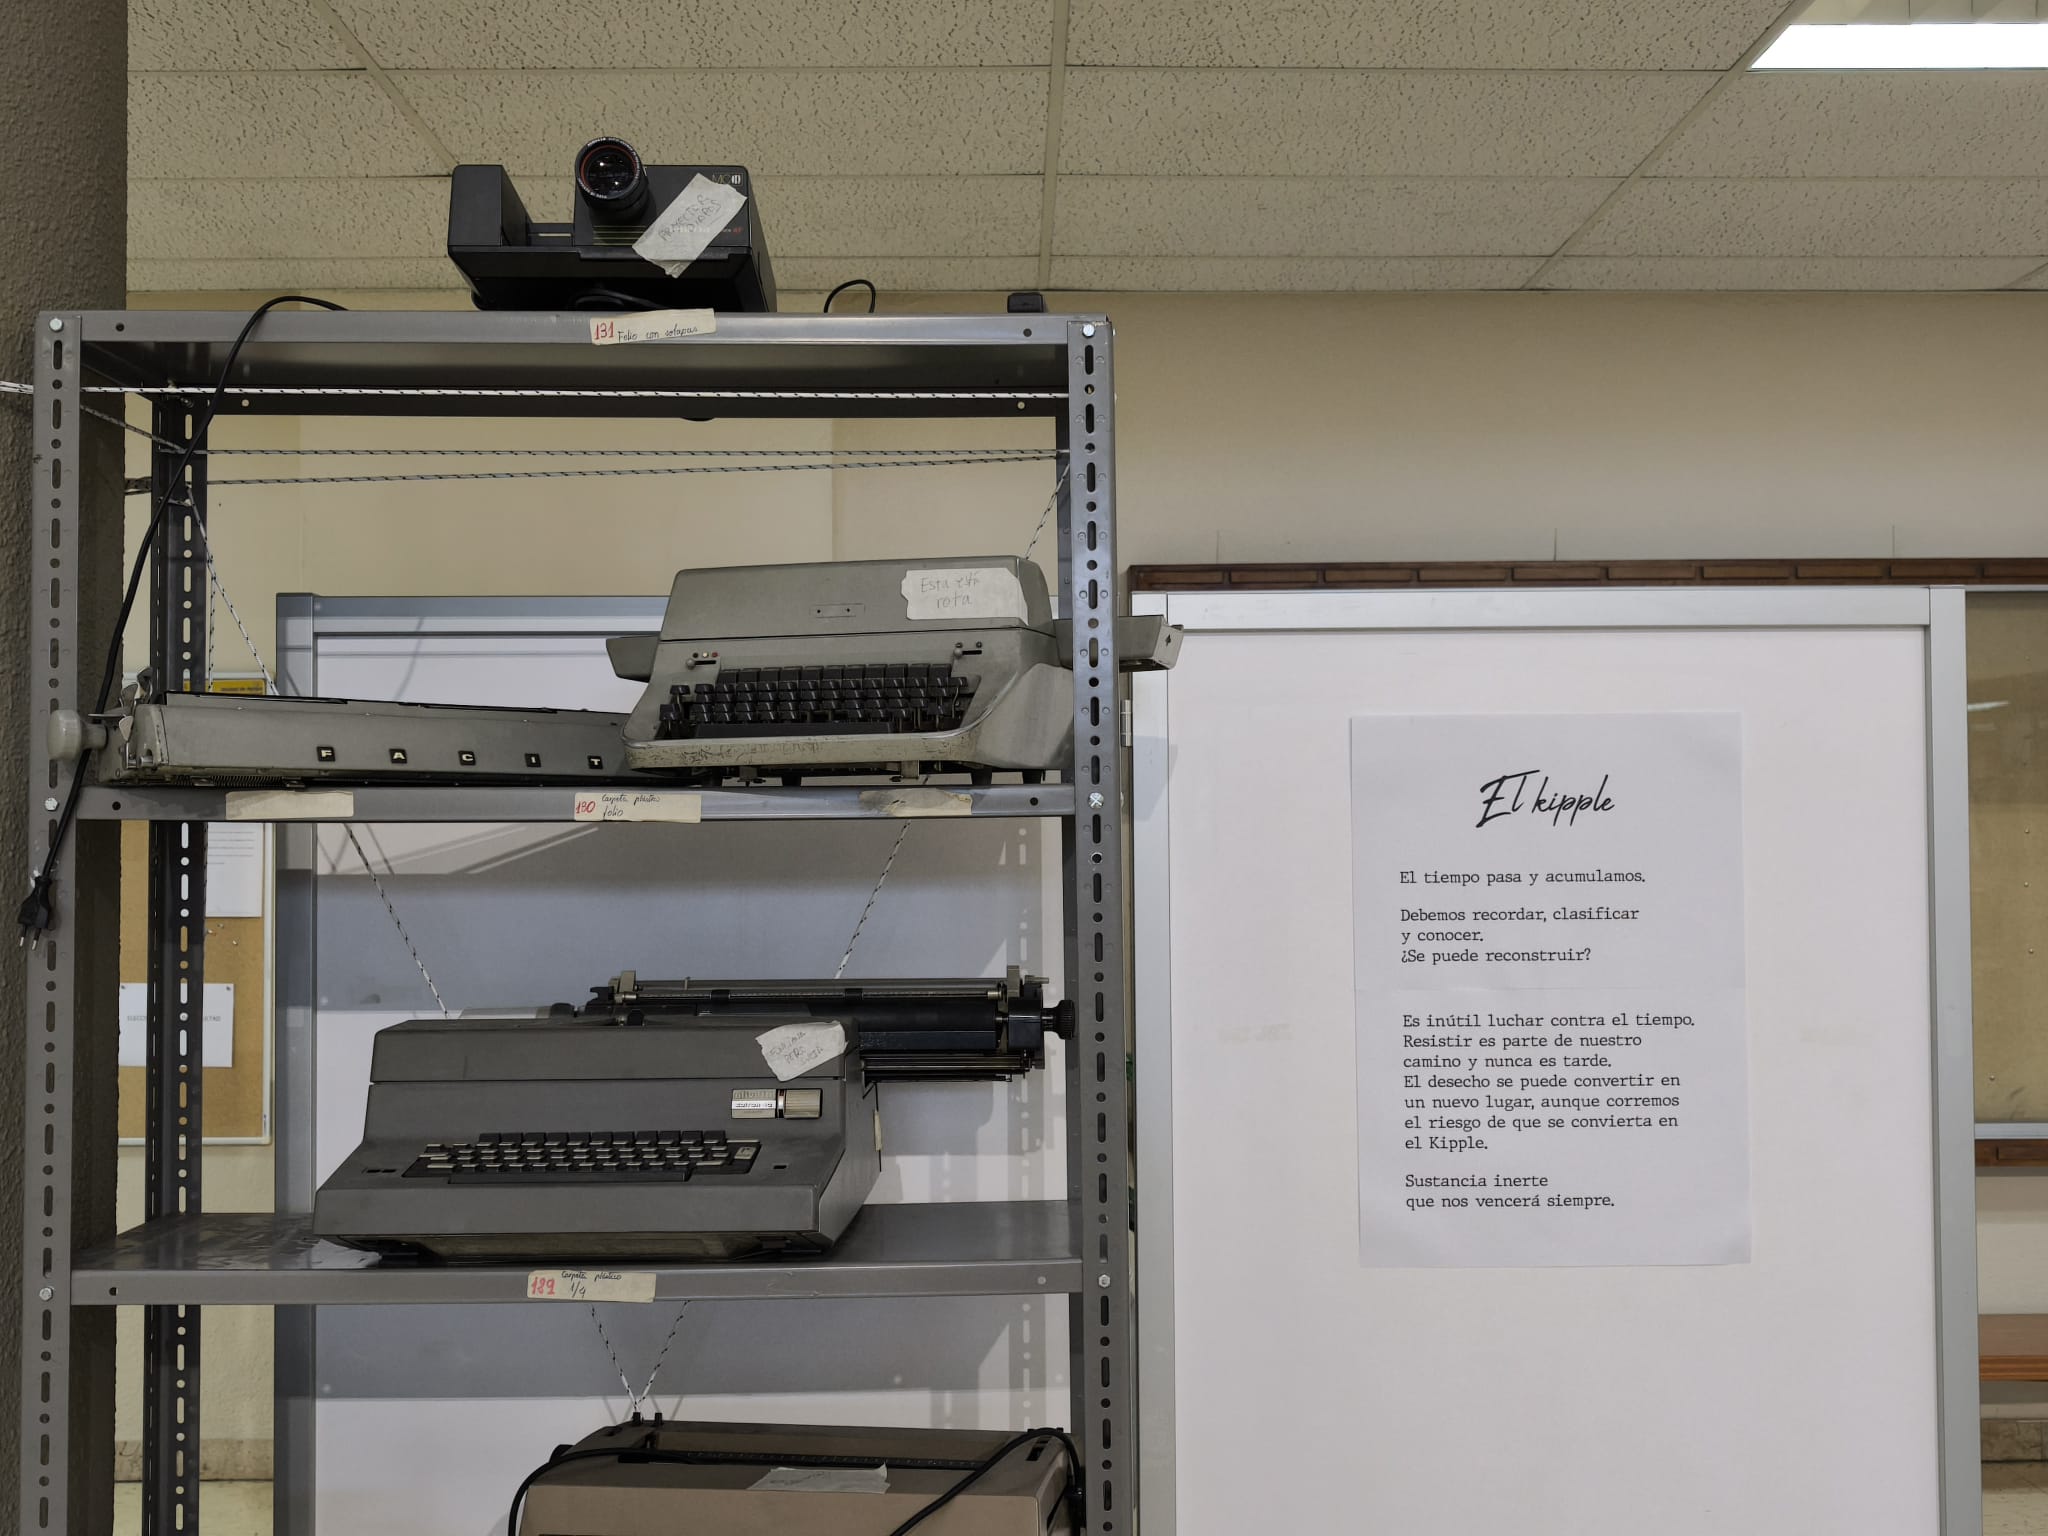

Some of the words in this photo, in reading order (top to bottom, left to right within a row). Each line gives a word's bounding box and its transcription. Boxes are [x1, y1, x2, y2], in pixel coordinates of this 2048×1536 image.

[1475, 769, 1540, 828] El
[1531, 774, 1615, 827] kipple
[1399, 870, 1418, 884] El
[1423, 870, 1481, 888] tiempo
[1485, 872, 1523, 887] pasa
[1528, 872, 1540, 887] y
[1544, 868, 1647, 883] acumulamos.
[1399, 907, 1467, 922] Debemos
[1471, 906, 1548, 924] recordar,
[1552, 906, 1641, 921] clasificar
[1400, 931, 1412, 946] y
[1417, 930, 1485, 942] conocer.
[1400, 948, 1426, 964] ¿Se
[1431, 948, 1480, 966] puede
[1484, 946, 1592, 962] reconstruir?
[1402, 1014, 1421, 1028] Es
[1426, 1013, 1482, 1028] inútil
[1487, 1013, 1545, 1028] luchar
[1550, 1013, 1607, 1027] contra
[1611, 1012, 1630, 1027] el
[1635, 1012, 1696, 1030] tiempo.
[1402, 1034, 1473, 1048] Resistir
[1478, 1036, 1496, 1048] es
[1501, 1035, 1549, 1051] parte
[1553, 1033, 1574, 1047] de
[1578, 1034, 1643, 1047] nuestro
[1402, 1054, 1462, 1068] camino
[1467, 1057, 1478, 1072] y
[1483, 1057, 1534, 1068] nunca
[1539, 1057, 1557, 1068] es
[1562, 1052, 1613, 1068] tarde.
[1403, 1074, 1422, 1089] El
[1427, 1074, 1491, 1089] desecho
[1496, 1077, 1514, 1088] se
[1519, 1073, 1568, 1092] puede
[1573, 1073, 1655, 1088] convertir
[1660, 1076, 1681, 1087] en
[1403, 1097, 1426, 1109] un
[1431, 1097, 1480, 1109] nuevo
[1485, 1094, 1536, 1112] lugar,
[1540, 1097, 1601, 1112] aunque
[1605, 1096, 1681, 1108] corremos
[1404, 1115, 1422, 1129] el
[1427, 1114, 1482, 1133] riesgo
[1487, 1114, 1507, 1129] de
[1512, 1117, 1542, 1133] que
[1547, 1117, 1565, 1129] se
[1570, 1114, 1653, 1129] convierta
[1658, 1116, 1680, 1127] en
[1404, 1135, 1423, 1150] el
[1428, 1135, 1489, 1153] Kipple.
[1405, 1173, 1488, 1188] Sustancia
[1493, 1173, 1549, 1188] inerte
[1405, 1197, 1436, 1212] que
[1440, 1197, 1469, 1208] nos
[1474, 1193, 1542, 1208] vencerá
[1546, 1193, 1616, 1211] siempre.
